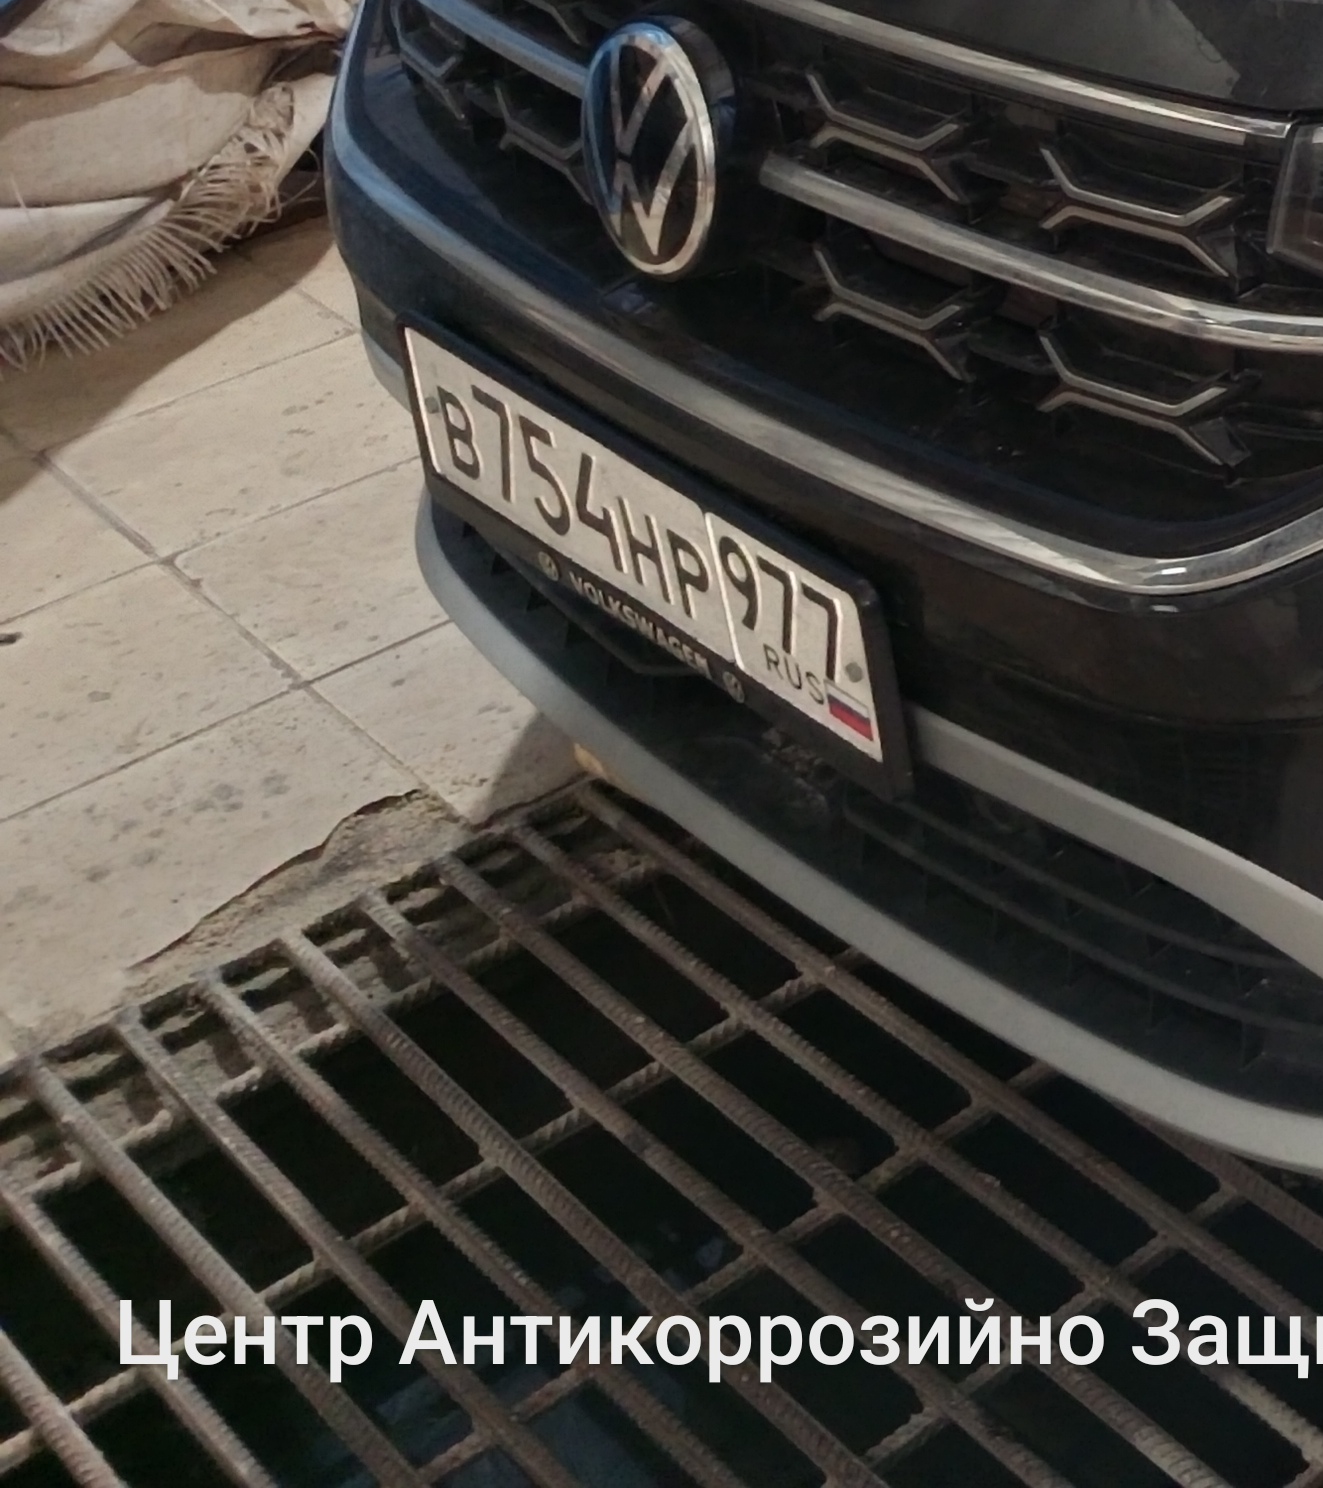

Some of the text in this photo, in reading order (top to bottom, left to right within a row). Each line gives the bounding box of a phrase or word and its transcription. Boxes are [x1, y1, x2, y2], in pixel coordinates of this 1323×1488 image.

[569, 569, 713, 682] VOLKSWAGEN
[719, 535, 842, 682] 977
[763, 642, 826, 705] RUS
